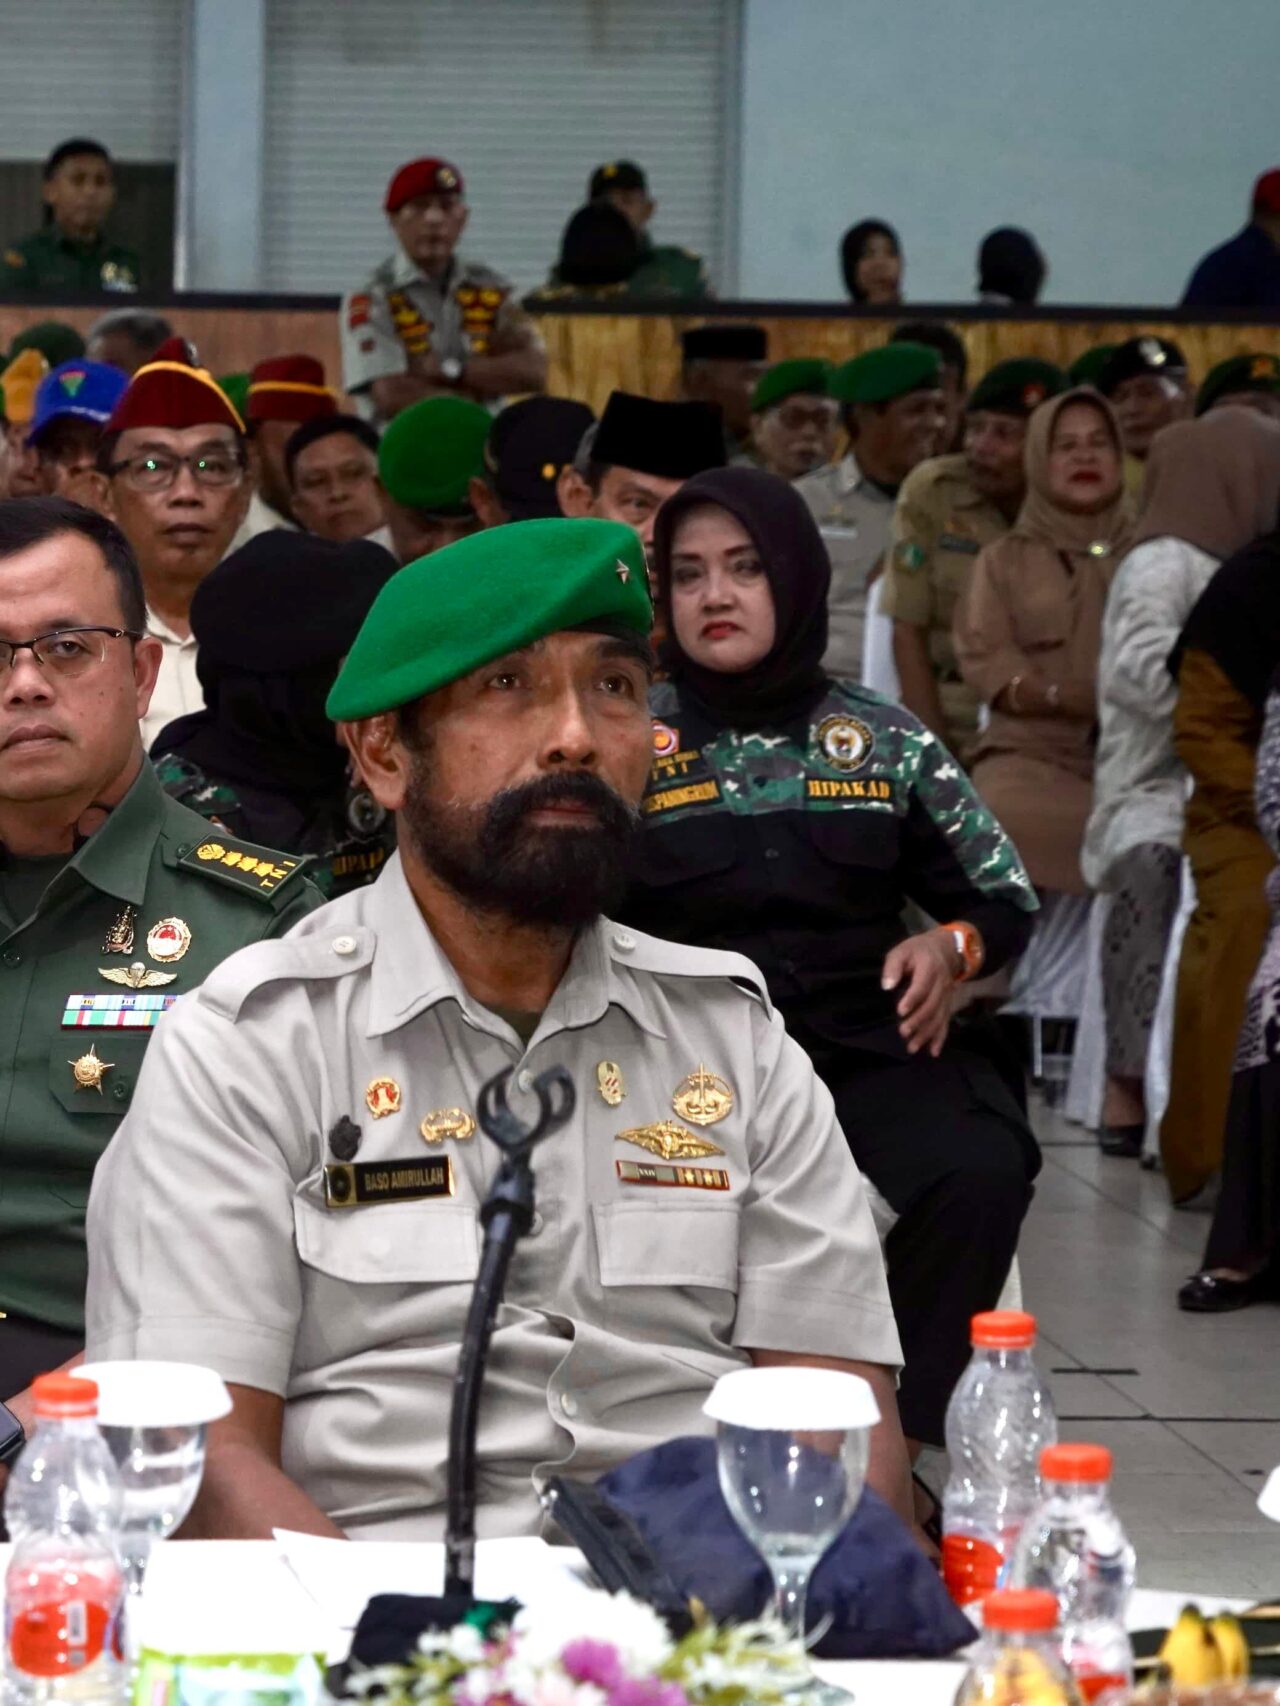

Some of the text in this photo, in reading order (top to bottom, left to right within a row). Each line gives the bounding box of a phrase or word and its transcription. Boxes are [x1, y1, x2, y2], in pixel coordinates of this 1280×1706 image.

[807, 780, 891, 799] HIPAKAD
[260, 860, 297, 888] TNI
[364, 1172, 390, 1192] BASO
